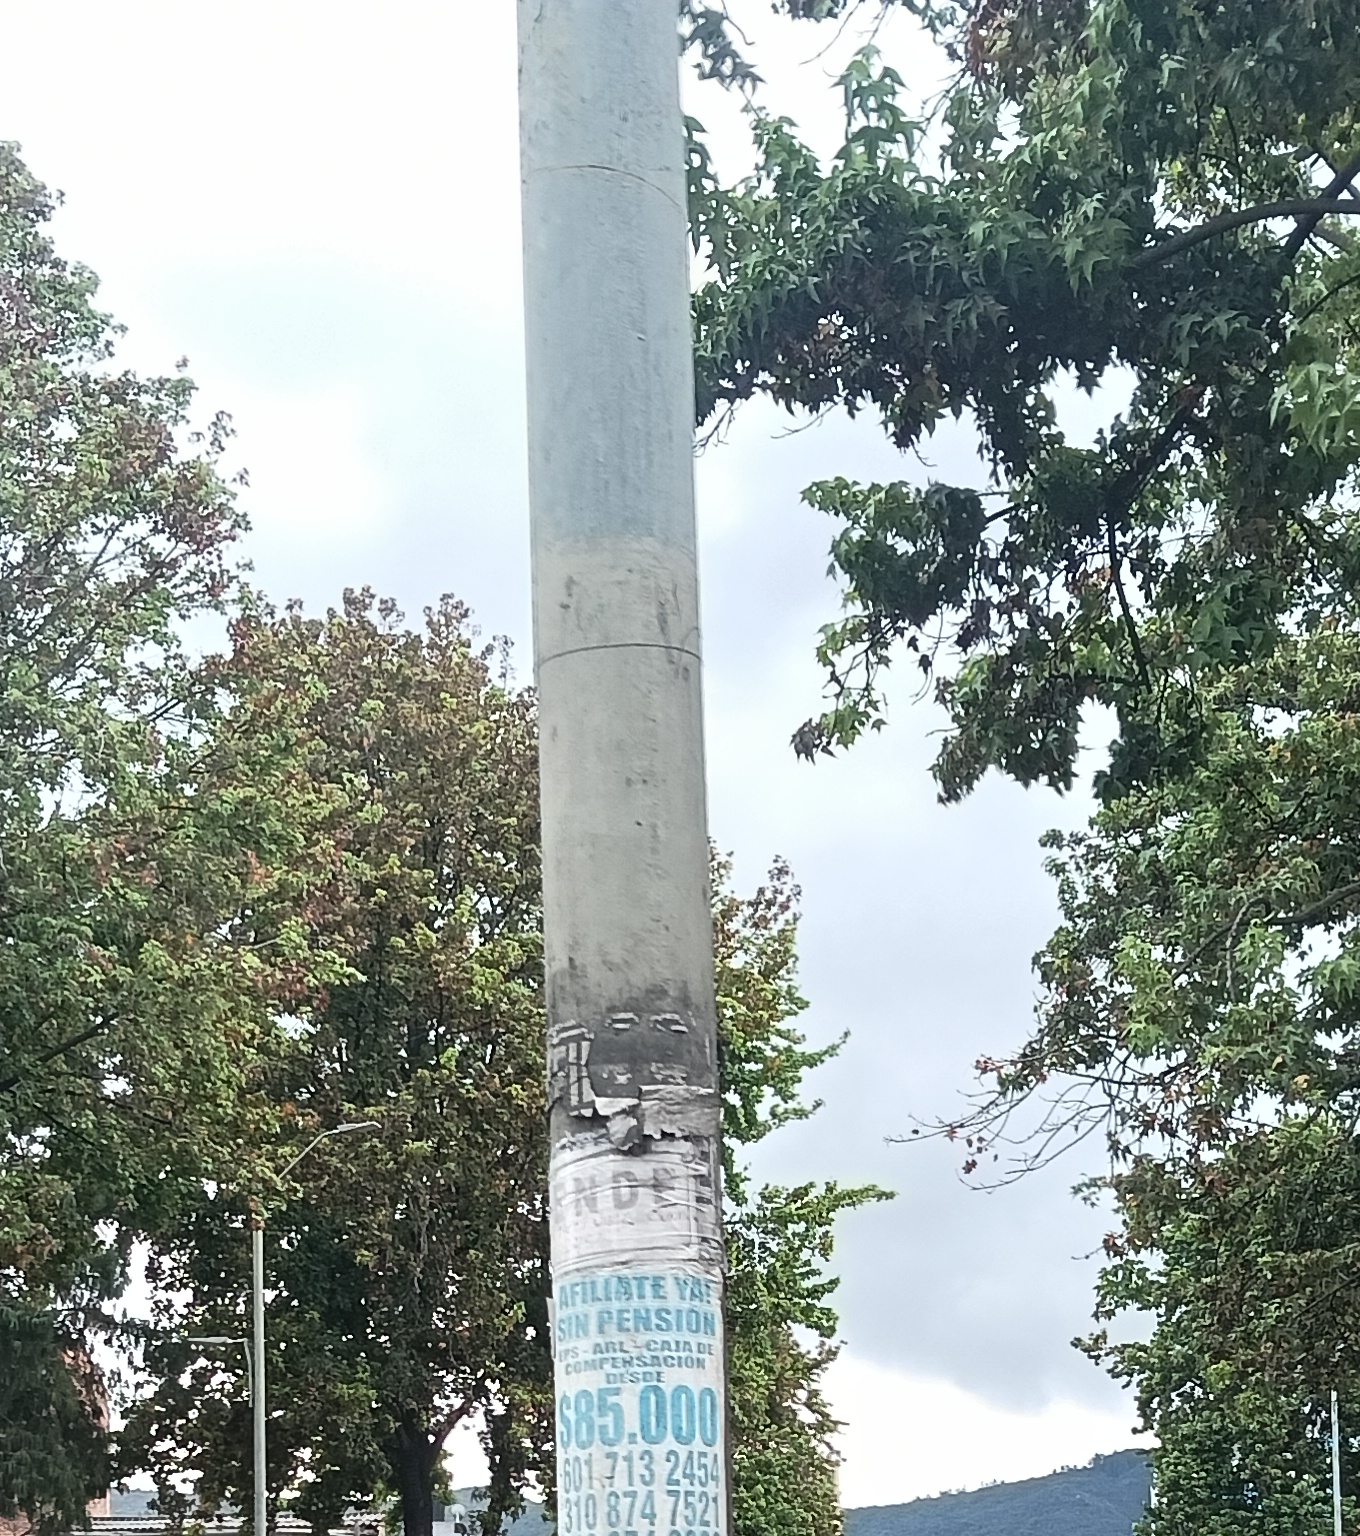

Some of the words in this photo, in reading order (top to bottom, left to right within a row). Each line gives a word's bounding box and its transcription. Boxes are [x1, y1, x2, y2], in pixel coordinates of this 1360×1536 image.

[559, 1276, 667, 1310] AFILIATE
[558, 1313, 589, 1342] SIN
[559, 1346, 579, 1362] EPS
[593, 1341, 629, 1355] ARL
[646, 1340, 693, 1353] CAJA
[697, 1342, 714, 1355] DE
[606, 1371, 666, 1384] DESDE
[559, 1384, 718, 1454] $85.000
[563, 1453, 594, 1494] 601
[605, 1450, 655, 1488] 713
[665, 1449, 720, 1489] 2454
[565, 1493, 597, 1533] 310
[607, 1490, 657, 1529] 874
[666, 1490, 720, 1529] 7521
